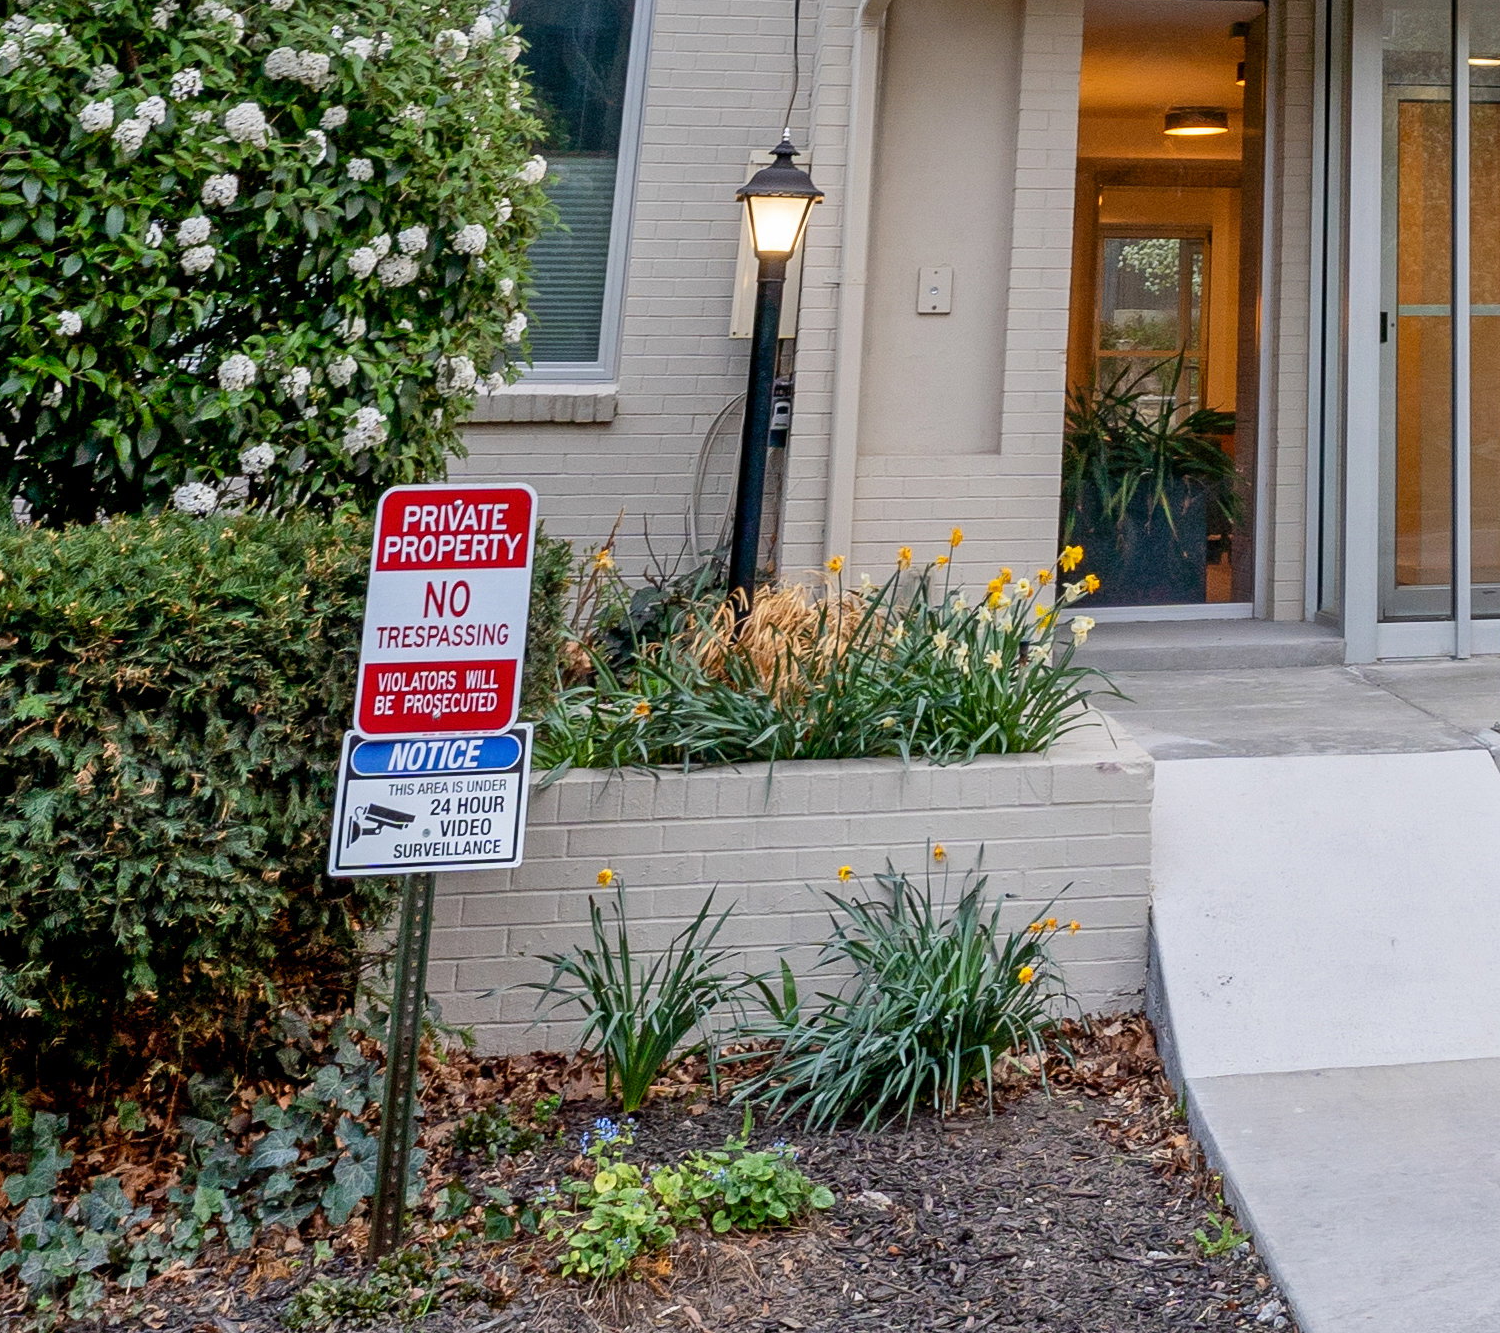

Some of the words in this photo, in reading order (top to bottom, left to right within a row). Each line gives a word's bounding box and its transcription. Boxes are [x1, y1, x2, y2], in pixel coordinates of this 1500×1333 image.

[402, 503, 510, 533] PRIVATE
[382, 533, 523, 564] PROPERTY
[423, 580, 471, 619] NO
[376, 623, 509, 649] TRESPASSING
[377, 670, 457, 693] VIOLATORS
[465, 669, 499, 689] WILL
[373, 694, 396, 716] BE
[403, 692, 498, 715] PROSECUTED
[387, 739, 484, 771] NOTICE
[388, 783, 414, 796] THIS
[417, 782, 449, 795] AREA
[452, 781, 463, 793] IS
[467, 779, 507, 793] UNDER
[430, 798, 451, 816] 24
[456, 795, 505, 815] HOUR
[440, 818, 492, 837] VIDEO
[393, 839, 502, 859] SURVEILLANCE
